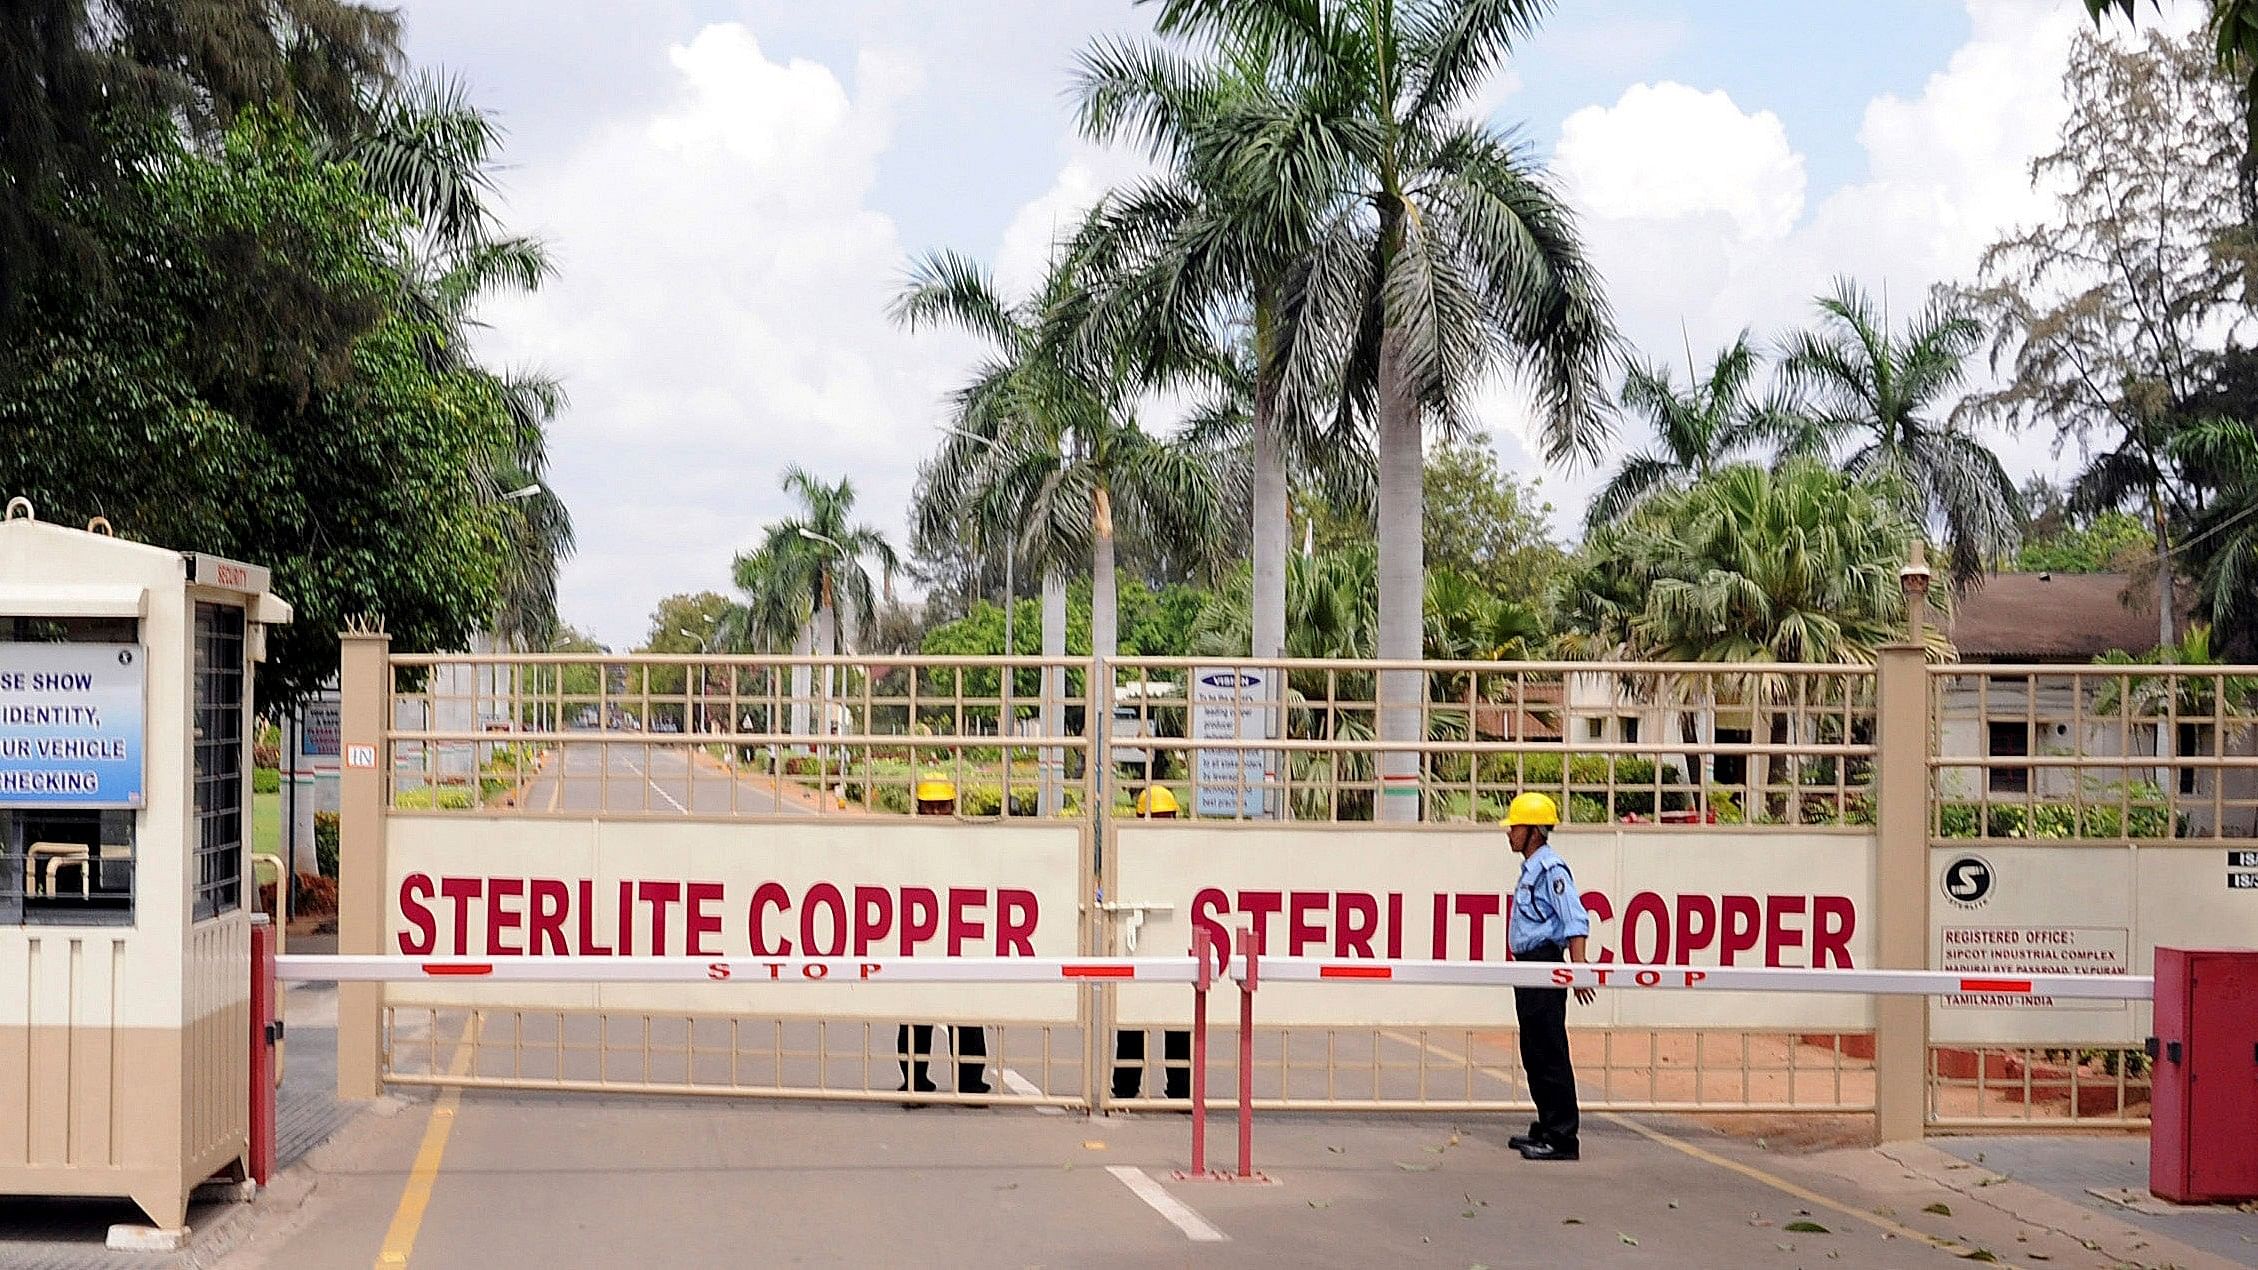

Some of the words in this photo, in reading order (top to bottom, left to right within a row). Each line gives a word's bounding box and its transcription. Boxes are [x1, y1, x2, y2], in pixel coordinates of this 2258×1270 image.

[33, 673, 92, 690] SHOW
[1213, 675, 1249, 687] VISIN
[3, 707, 100, 727] IDENTITY,
[38, 739, 126, 758] VEHICLE
[354, 748, 372, 765] IN
[0, 773, 97, 791] HECKING
[397, 873, 725, 956] STERLITE
[749, 882, 1039, 957] COPPER
[1188, 888, 1517, 966] STERLIT
[1577, 891, 1856, 969] COPPER
[1945, 931, 2020, 944] REGISTERED
[1945, 950, 1987, 960] SIPCOT
[1990, 949, 2059, 960] INDUSTRIAL
[2061, 950, 2116, 960] COMPLEX
[708, 963, 882, 981] STOP
[1551, 968, 1707, 988] STOP
